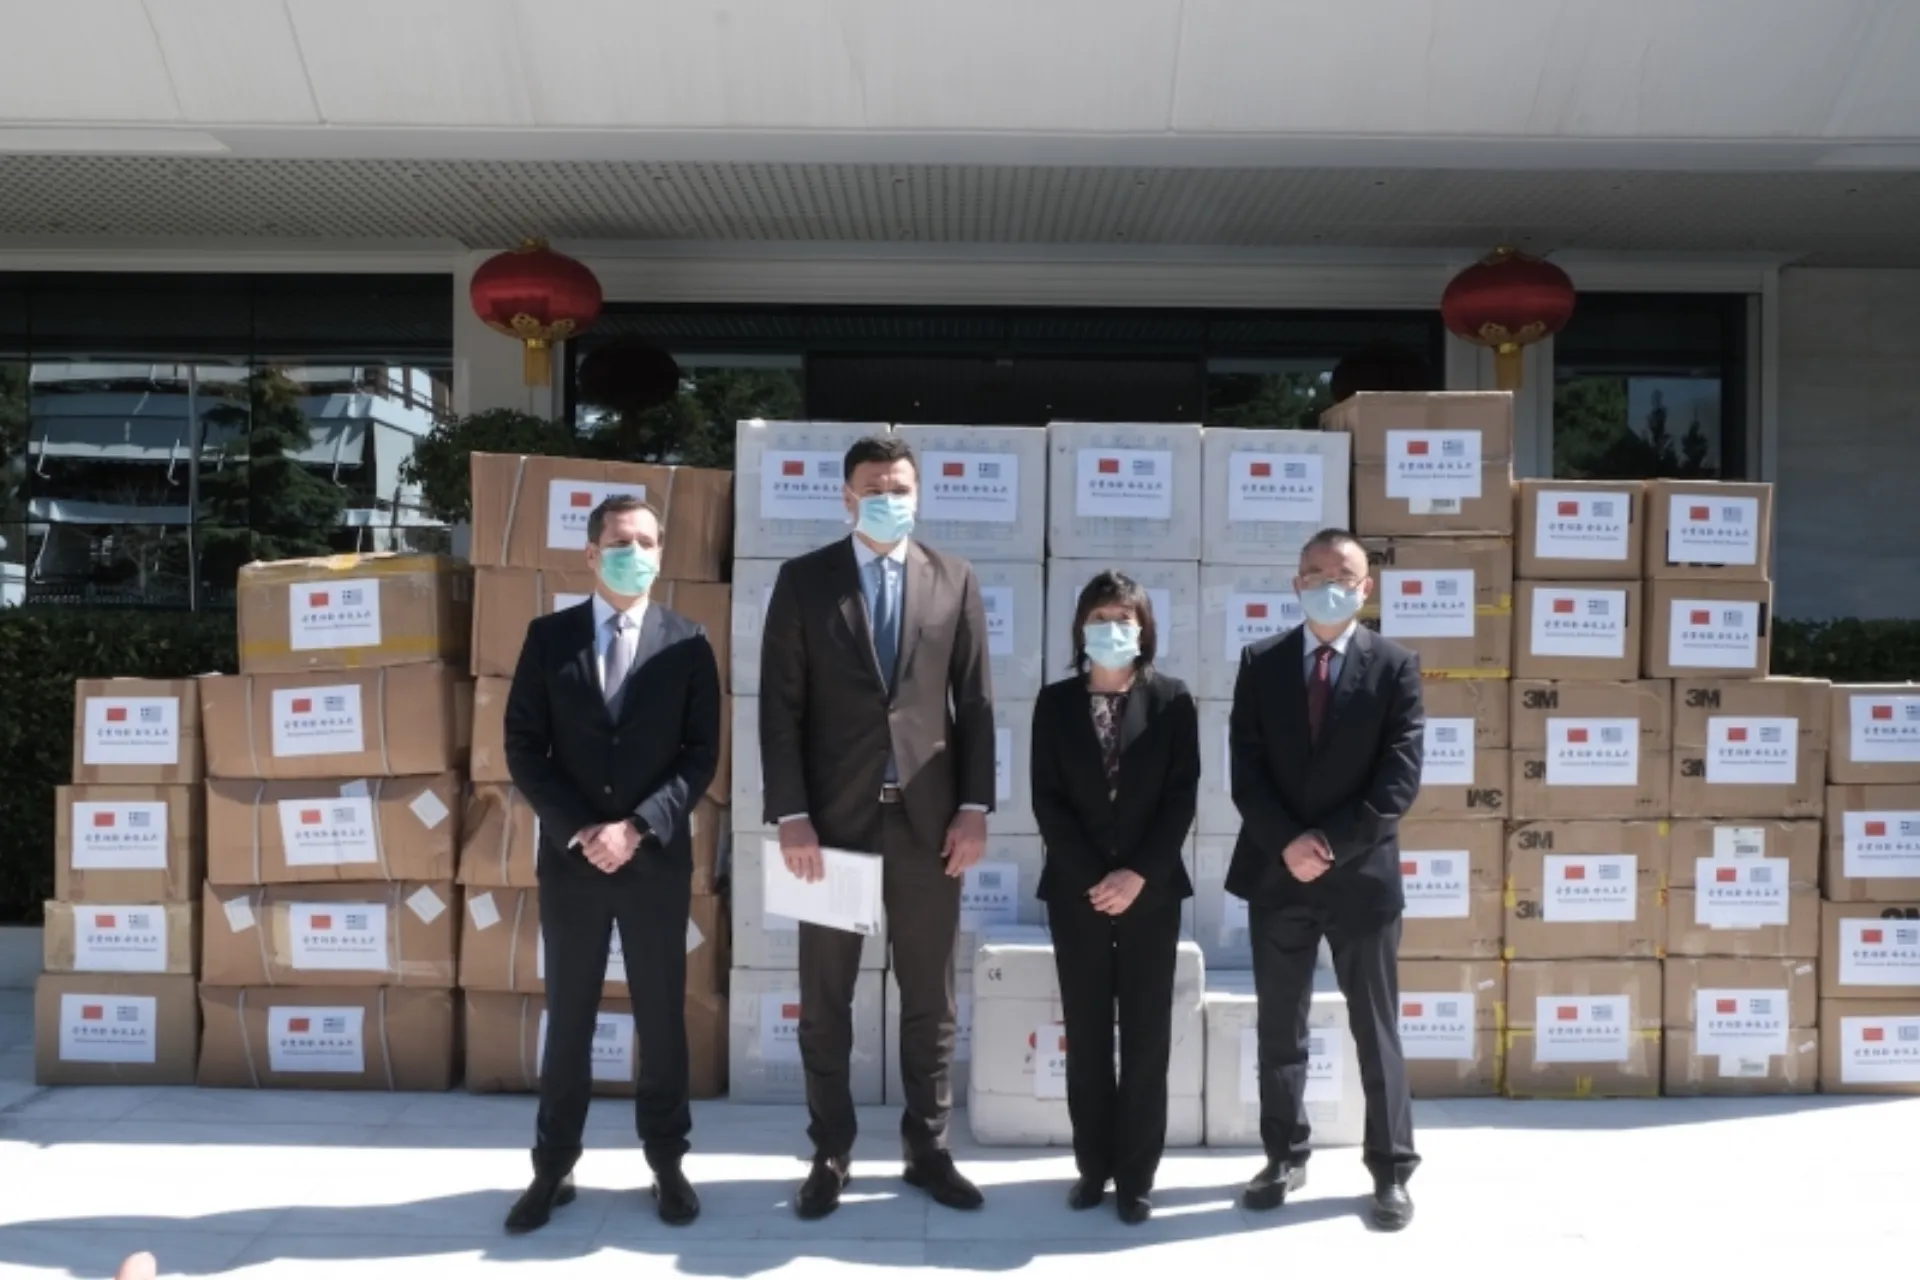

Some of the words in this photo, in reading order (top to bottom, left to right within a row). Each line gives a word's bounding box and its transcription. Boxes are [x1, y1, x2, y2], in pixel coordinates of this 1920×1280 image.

[1523, 689, 1558, 709] 3M
[1685, 689, 1721, 708] 3M
[1466, 788, 1503, 808] 3M
[1517, 830, 1554, 851] 3M
